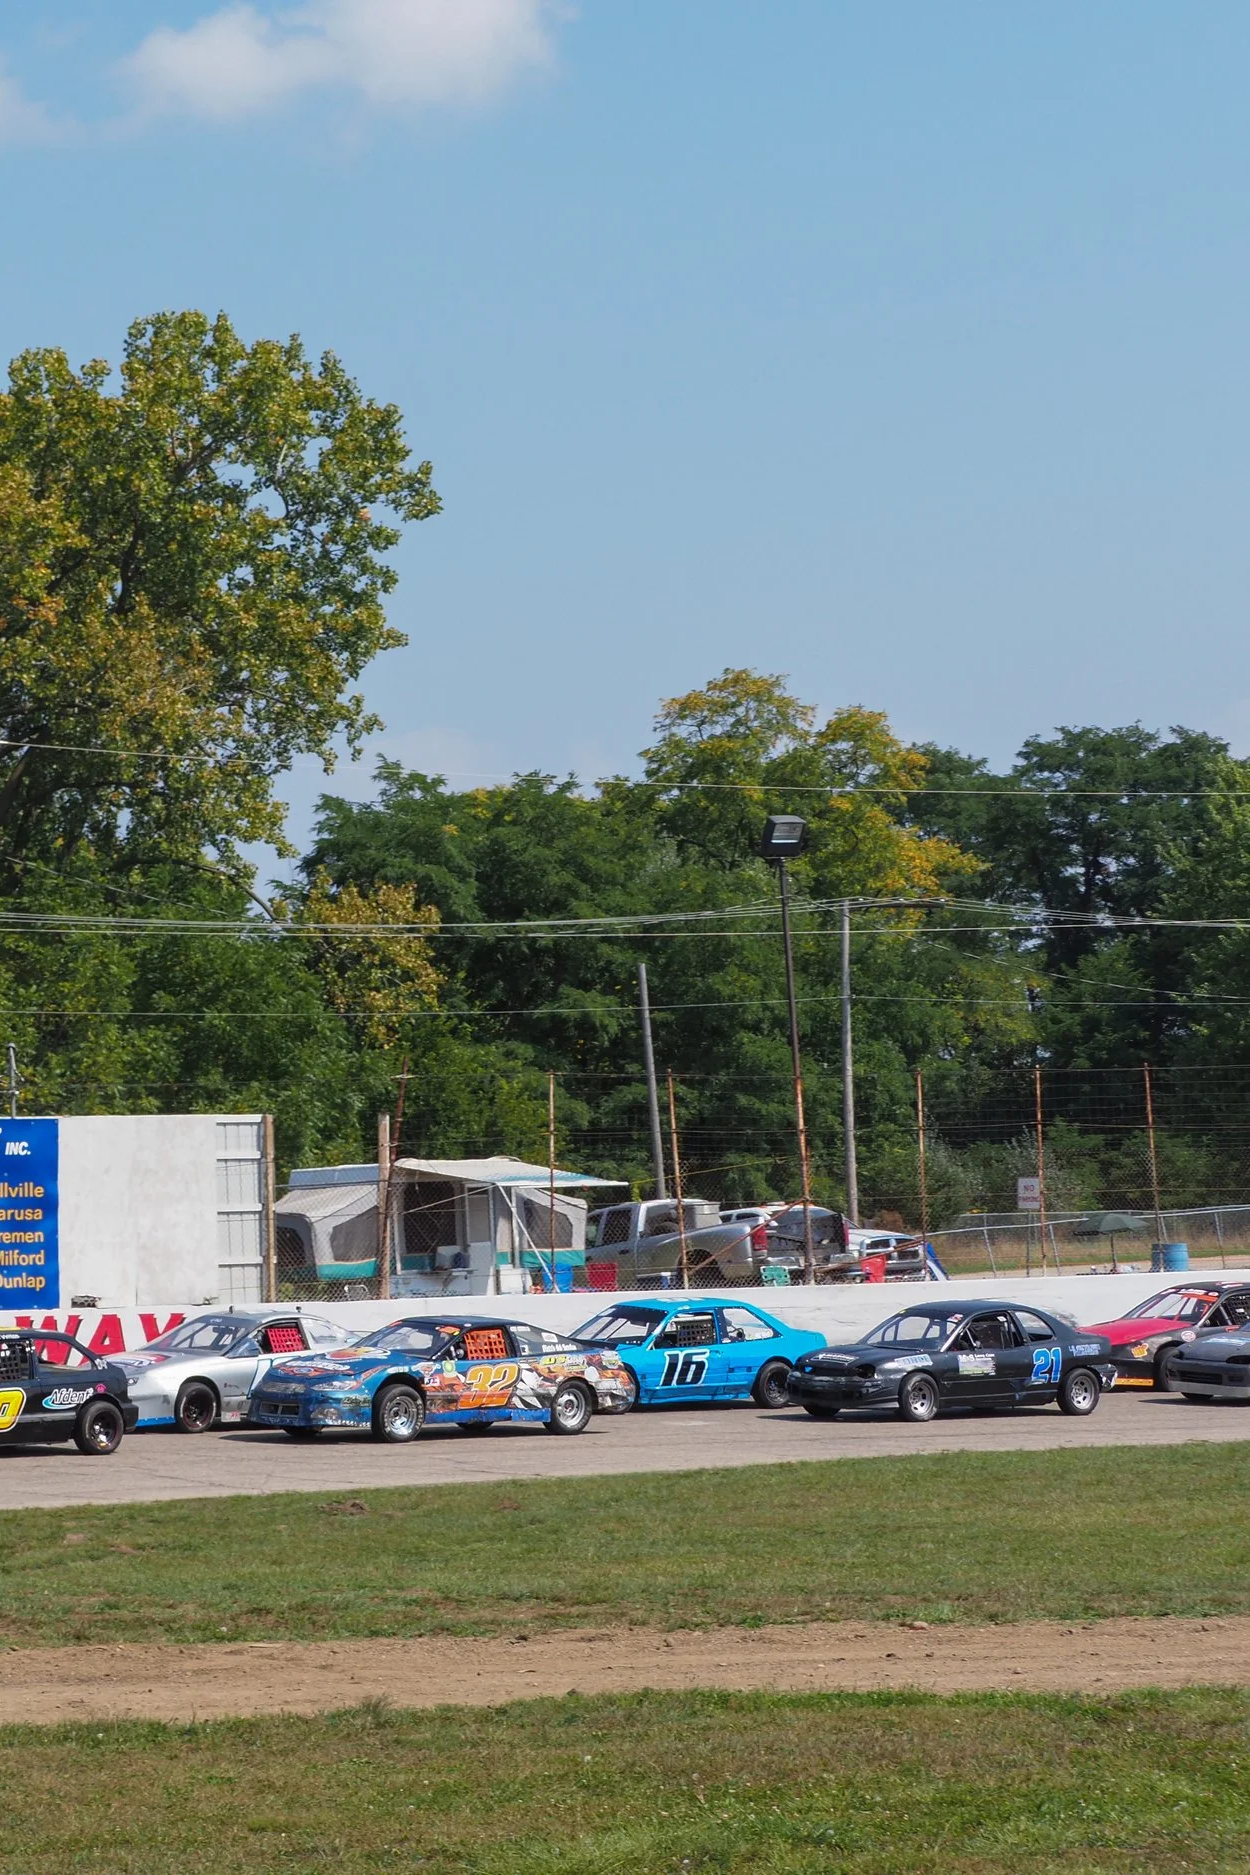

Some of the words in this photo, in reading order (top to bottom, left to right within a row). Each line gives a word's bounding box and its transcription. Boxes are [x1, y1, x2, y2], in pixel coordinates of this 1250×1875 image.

[5, 1141, 31, 1156] INC.
[660, 1349, 710, 1387] 16
[1031, 1346, 1062, 1383] 21
[457, 1362, 521, 1410] 32
